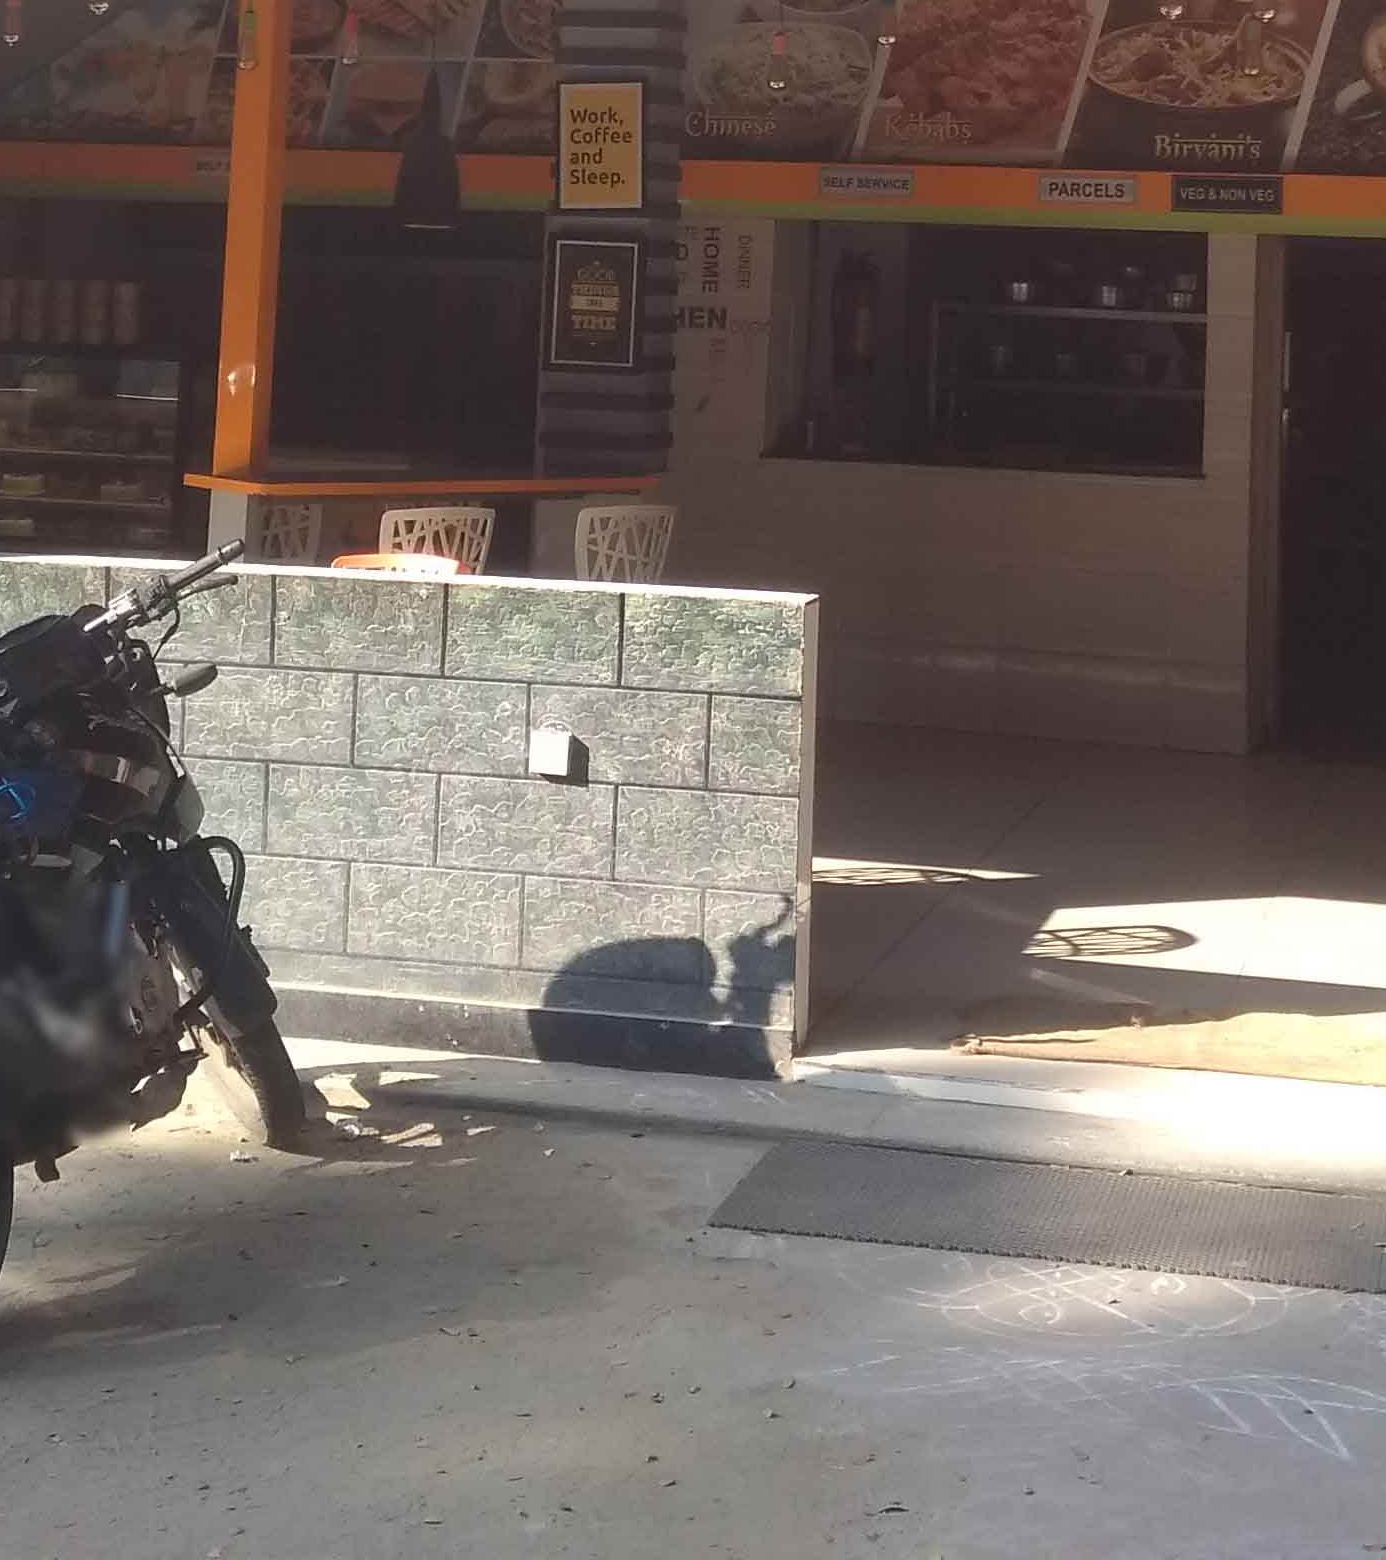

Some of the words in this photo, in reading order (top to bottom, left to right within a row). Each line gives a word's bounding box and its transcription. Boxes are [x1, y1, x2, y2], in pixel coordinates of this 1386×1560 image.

[569, 106, 624, 126] Work,
[685, 108, 777, 137] Chinese
[570, 127, 633, 144] Coffee
[570, 147, 603, 165] and
[570, 169, 626, 188] Sleep.
[823, 175, 853, 190] SELF
[856, 177, 910, 192] SERVICE
[1048, 181, 1125, 199] PARCELS
[1179, 187, 1205, 201] VEG
[1219, 189, 1246, 202] NON
[1249, 190, 1275, 203] VEG
[702, 226, 721, 293] HOME
